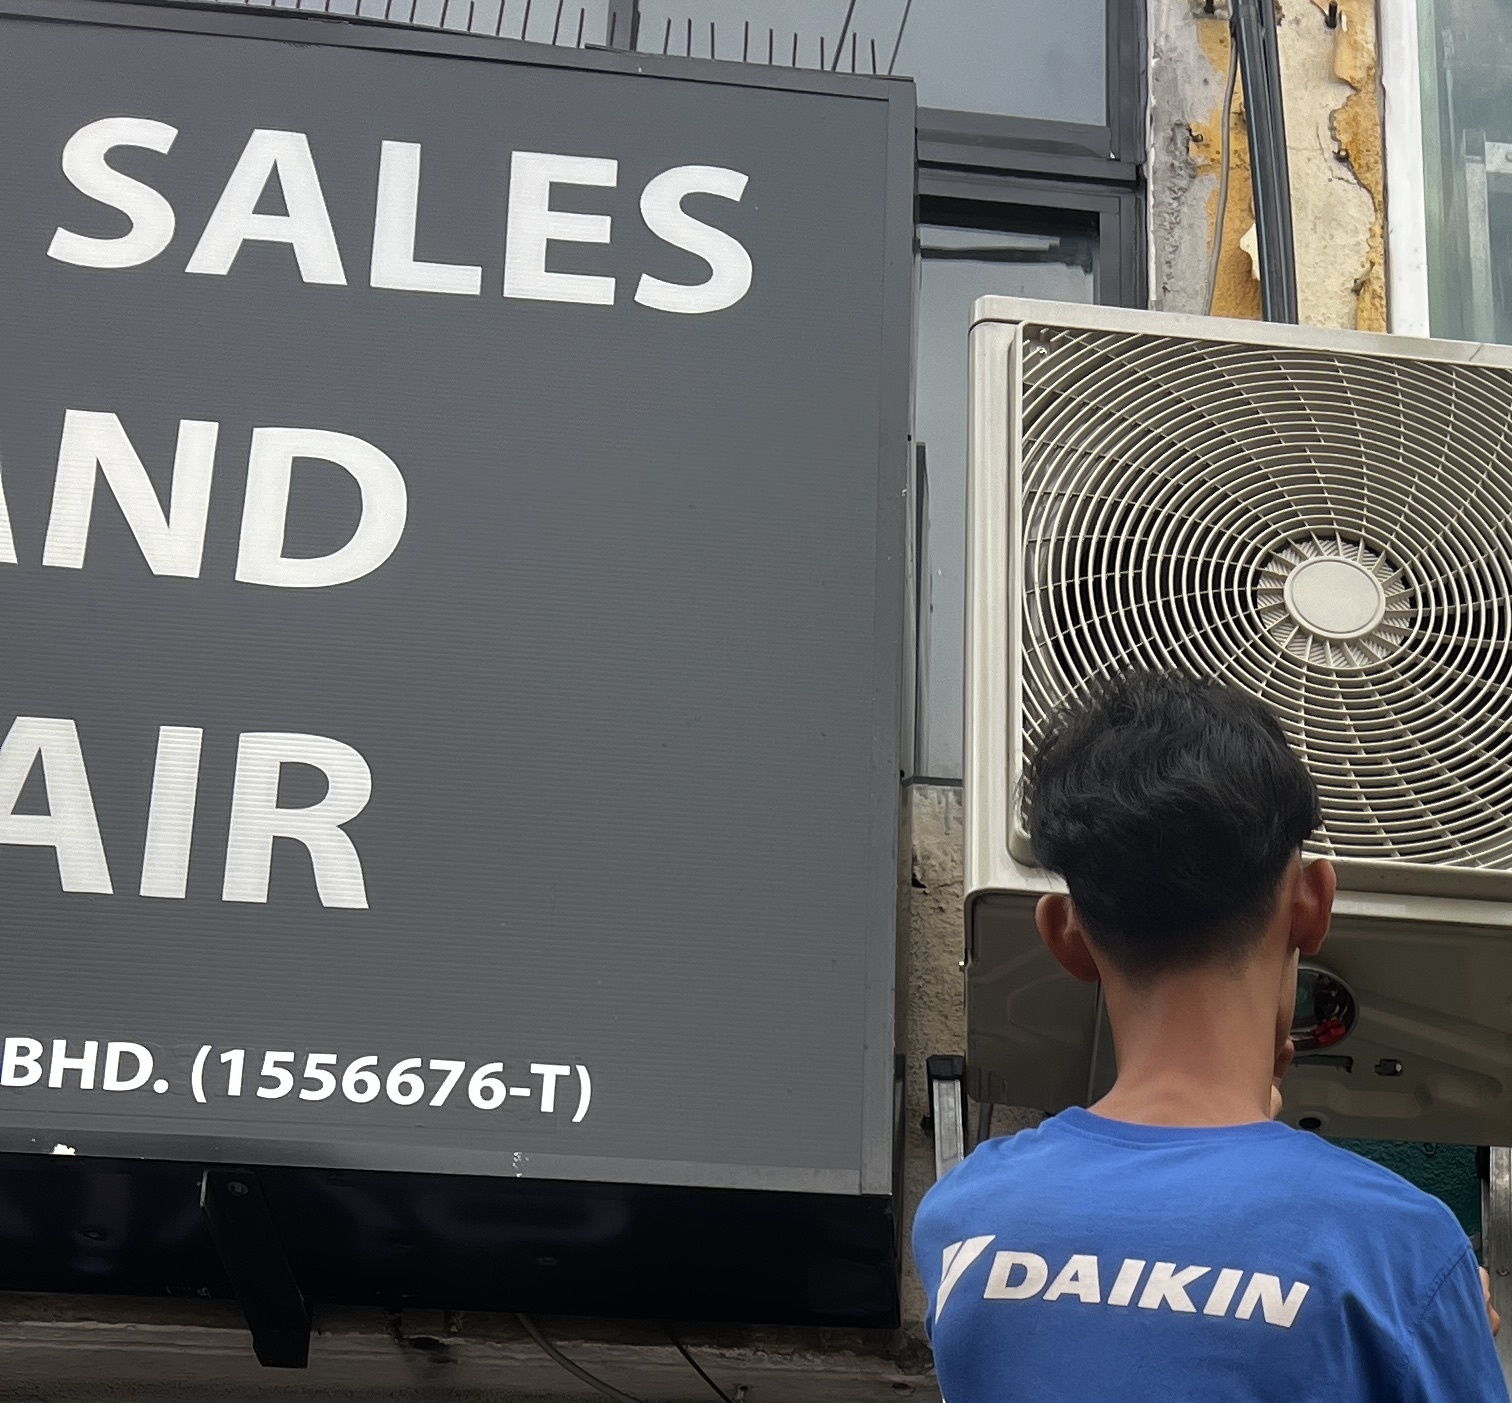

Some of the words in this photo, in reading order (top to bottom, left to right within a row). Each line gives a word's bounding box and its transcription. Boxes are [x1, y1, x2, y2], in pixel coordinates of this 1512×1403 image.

[46, 116, 753, 314] SALES
[0, 408, 408, 588] ND
[1, 1037, 169, 1094] BHD.
[191, 1044, 592, 1123] (1556676-T)
[983, 1250, 1310, 1328] DAIKIN
